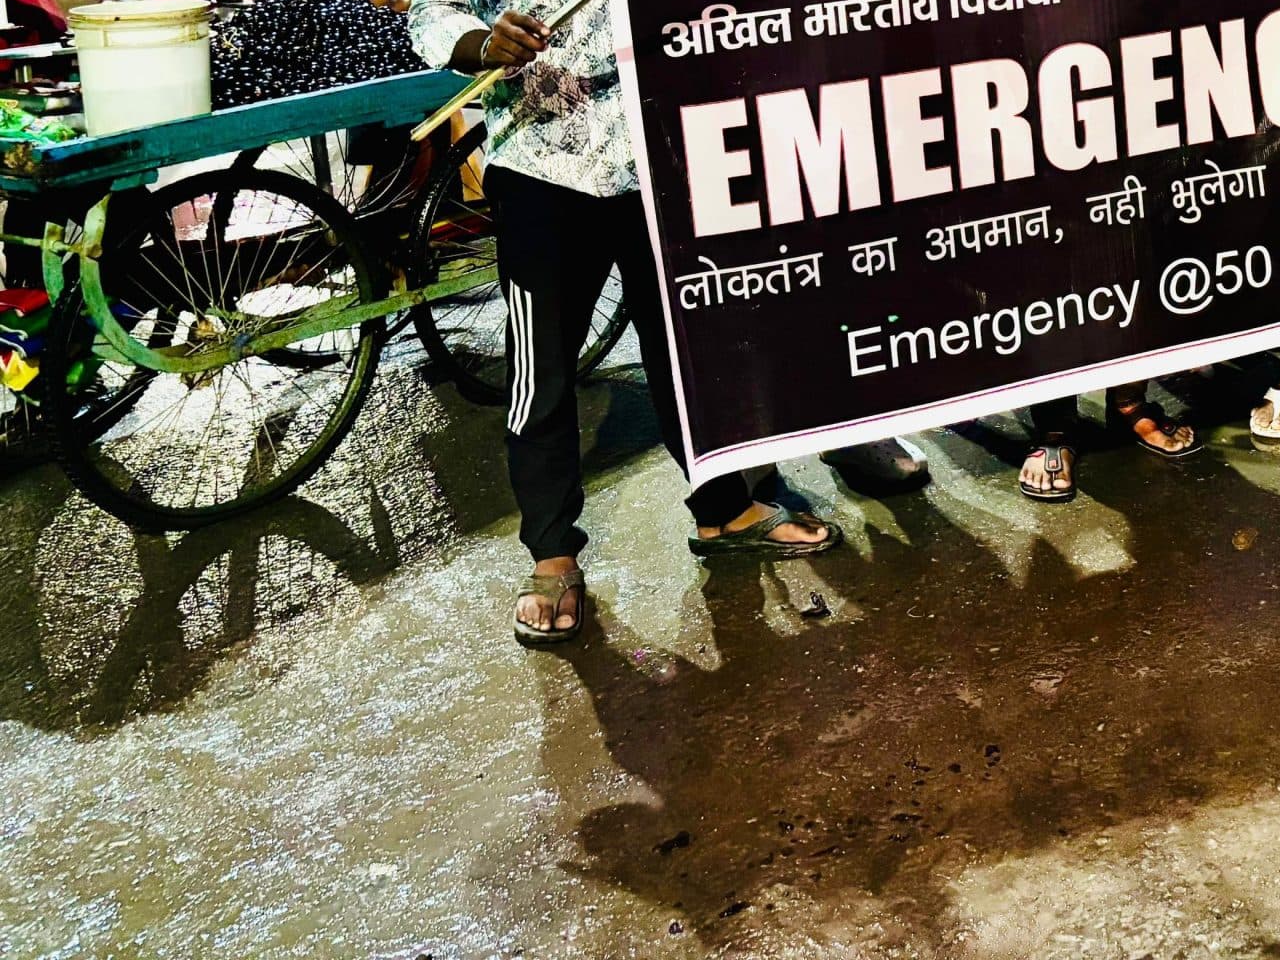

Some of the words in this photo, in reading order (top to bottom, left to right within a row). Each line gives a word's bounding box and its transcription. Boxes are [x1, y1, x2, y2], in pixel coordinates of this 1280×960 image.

[662, 4, 792, 58] अखिल
[675, 244, 823, 311] लोकतंत्र
[849, 236, 896, 277] का
[925, 204, 1064, 261] अपमान,
[1086, 176, 1146, 226] नही
[1172, 160, 1265, 223] भुलेगा
[846, 277, 1140, 377] Emergency
[1159, 244, 1273, 316] @50
